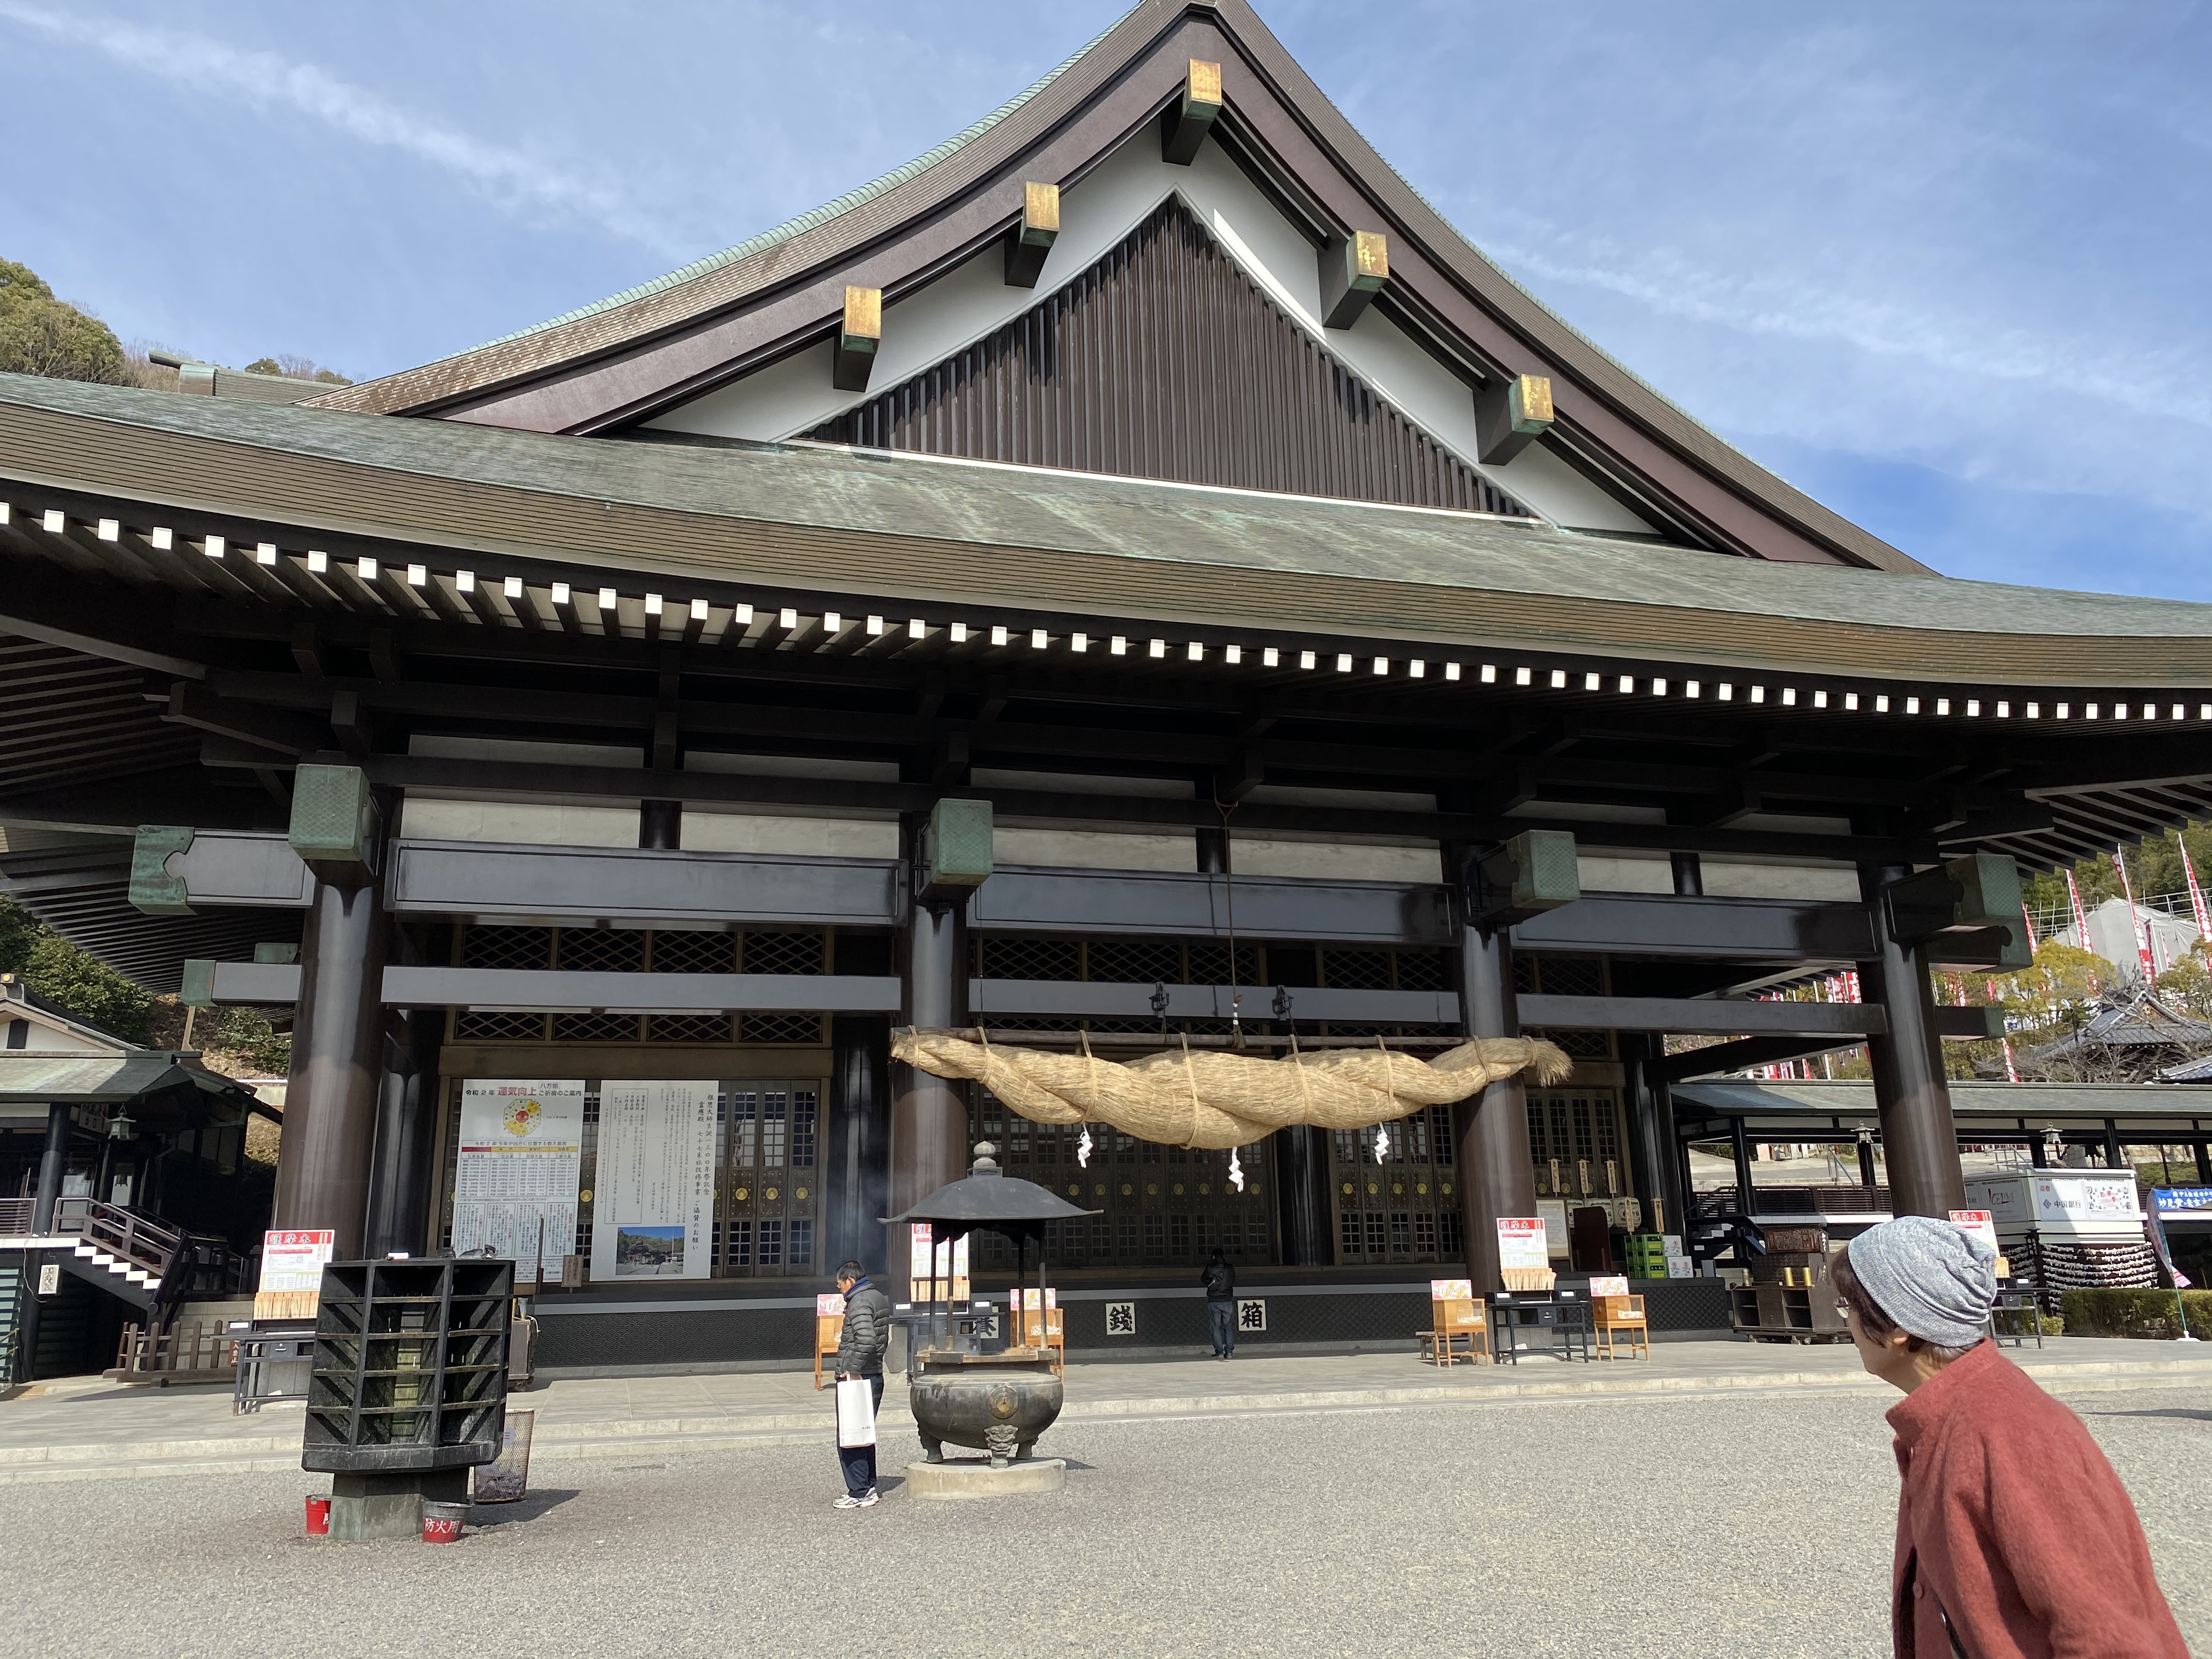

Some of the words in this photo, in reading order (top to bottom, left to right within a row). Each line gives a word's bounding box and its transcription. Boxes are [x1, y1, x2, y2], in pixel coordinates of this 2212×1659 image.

[498, 1086, 537, 1096] 運気向上
[2054, 1200, 2081, 1209] 中国銀行
[1500, 1221, 1530, 1229] 護摩木
[269, 1233, 312, 1245] 護摩木
[1240, 1301, 1263, 1329] 箱
[230, 1340, 240, 1363] 入禁止
[424, 1517, 460, 1534] 防火用
